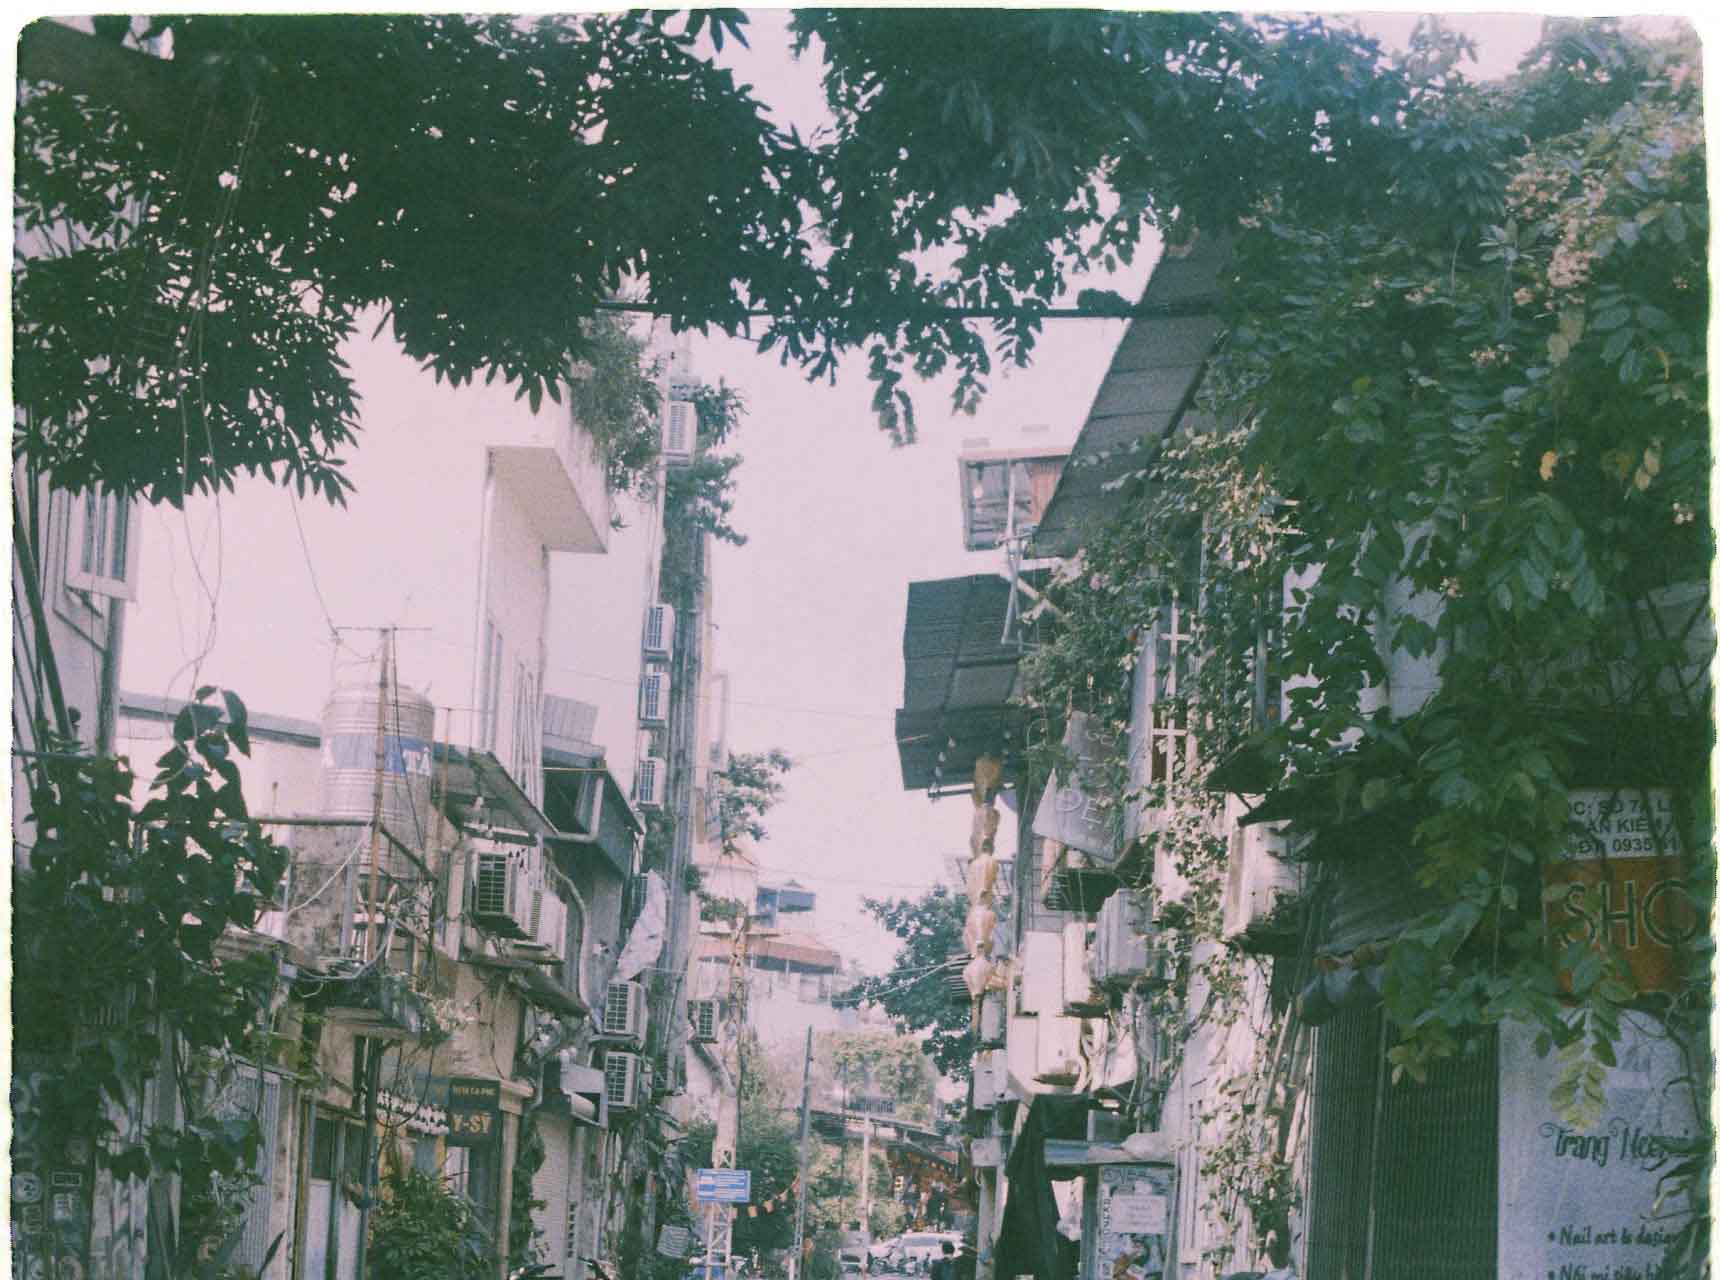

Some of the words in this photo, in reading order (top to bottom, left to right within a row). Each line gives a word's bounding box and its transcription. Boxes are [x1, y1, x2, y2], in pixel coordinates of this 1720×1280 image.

[1538, 1122, 1611, 1168] Trang
[1560, 1223, 1591, 1247] Nail
[1594, 1228, 1617, 1245] art
